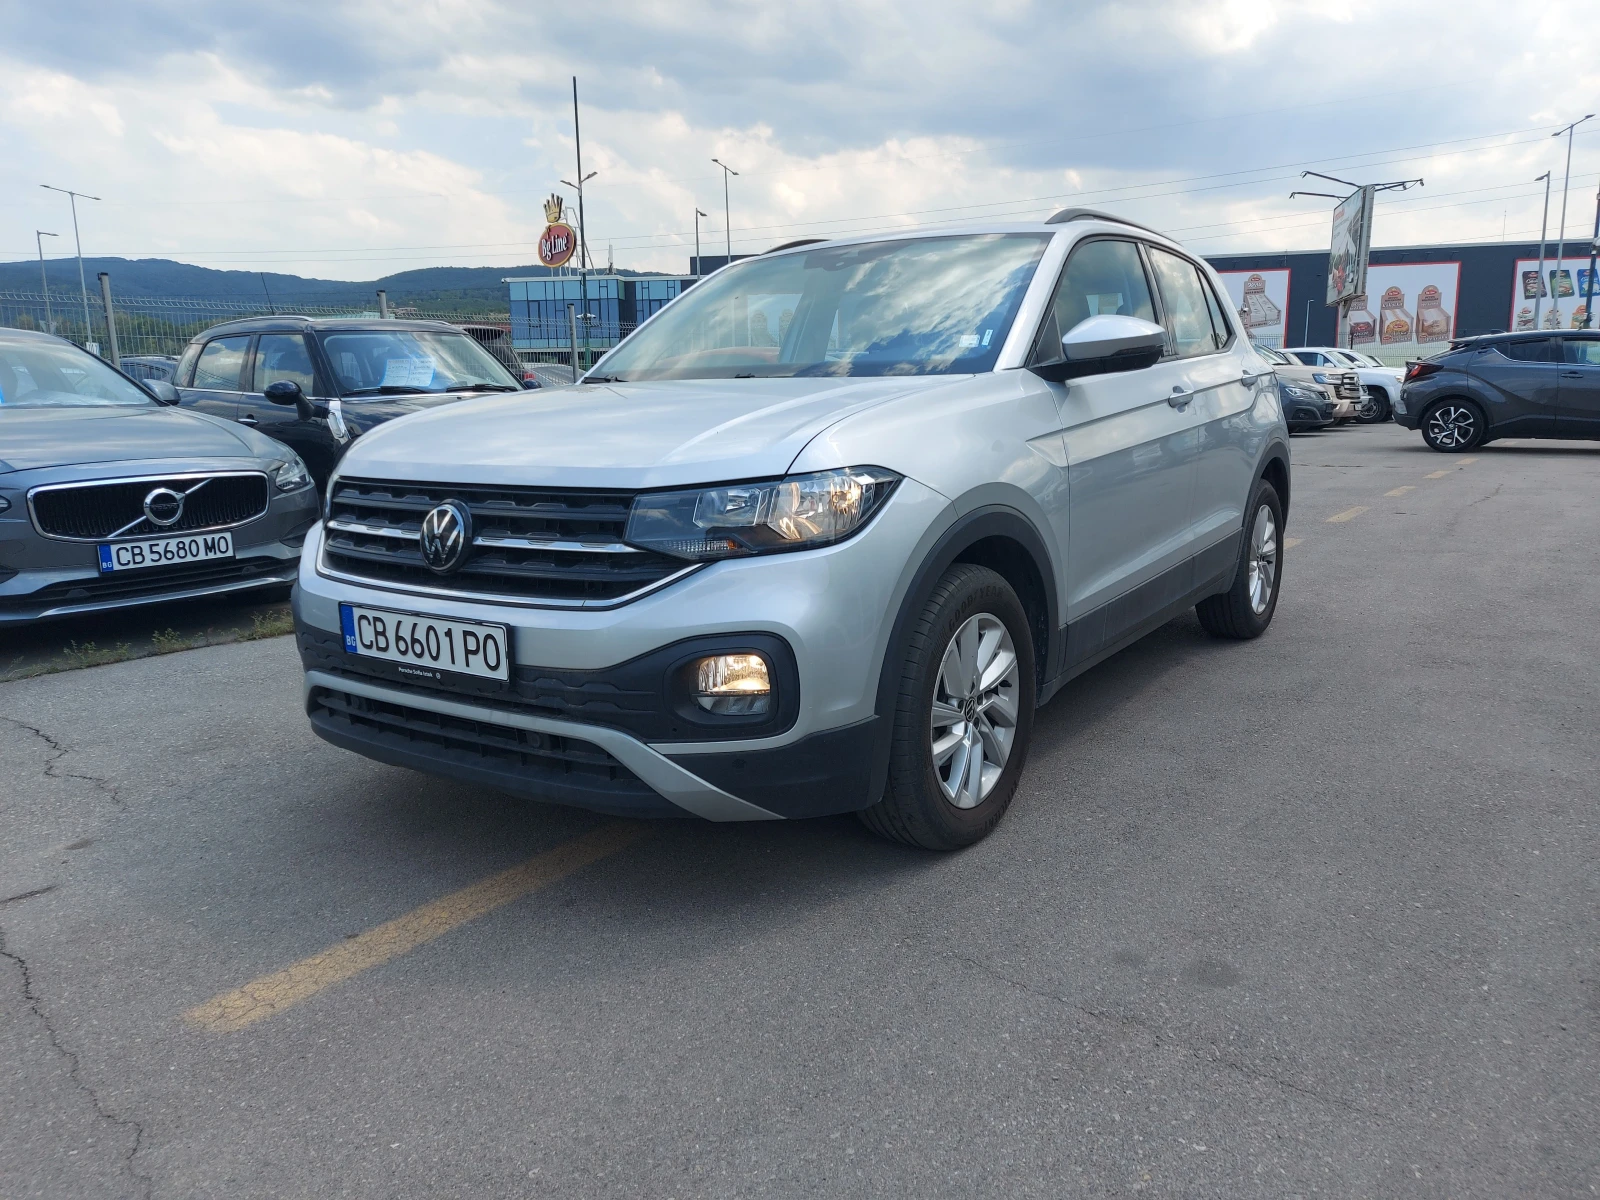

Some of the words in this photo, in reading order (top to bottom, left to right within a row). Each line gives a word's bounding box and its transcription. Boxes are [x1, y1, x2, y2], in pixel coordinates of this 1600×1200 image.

[541, 239, 552, 260] Bg
[551, 234, 567, 254] Line
[116, 545, 145, 567] CB
[149, 539, 200, 562] 5680
[203, 536, 229, 556] MO
[346, 635, 356, 647] BG
[357, 614, 390, 652] CB
[395, 620, 456, 665] 6601
[462, 630, 500, 671] PO
